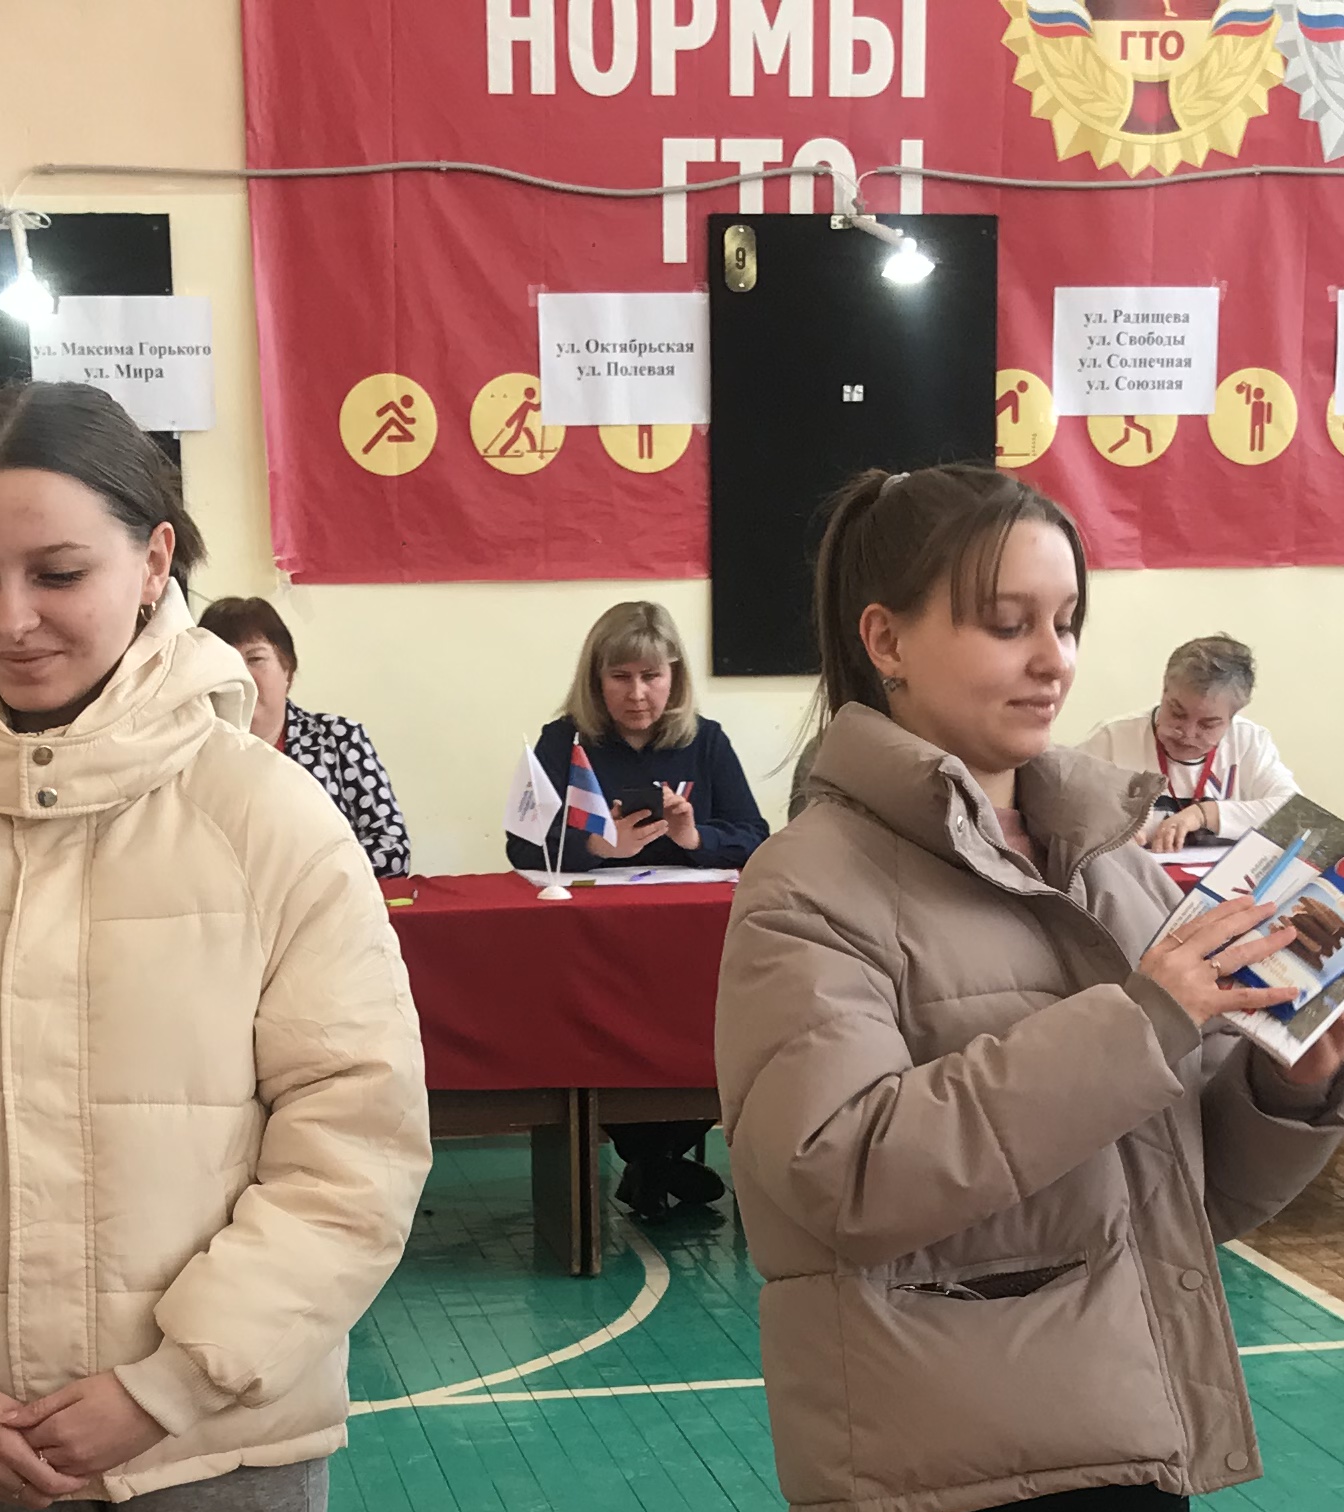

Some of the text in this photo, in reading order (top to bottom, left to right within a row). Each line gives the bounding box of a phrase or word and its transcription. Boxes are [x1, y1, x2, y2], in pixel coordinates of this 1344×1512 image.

[486, 0, 926, 97] НОРМЫ
[1120, 30, 1185, 61] ГТО
[735, 247, 746, 270] 9
[1083, 309, 1190, 328] ул. Радищева
[556, 338, 695, 358] ул. Октябрьская
[1087, 331, 1186, 350] ул. Свободы
[33, 342, 212, 360] ул. Максима Горького
[577, 361, 675, 381] ул. Полевая
[1077, 353, 1192, 373] ул. Солнечная
[84, 364, 164, 383] ул. Мира
[1085, 376, 1184, 395] ул. Союзная
